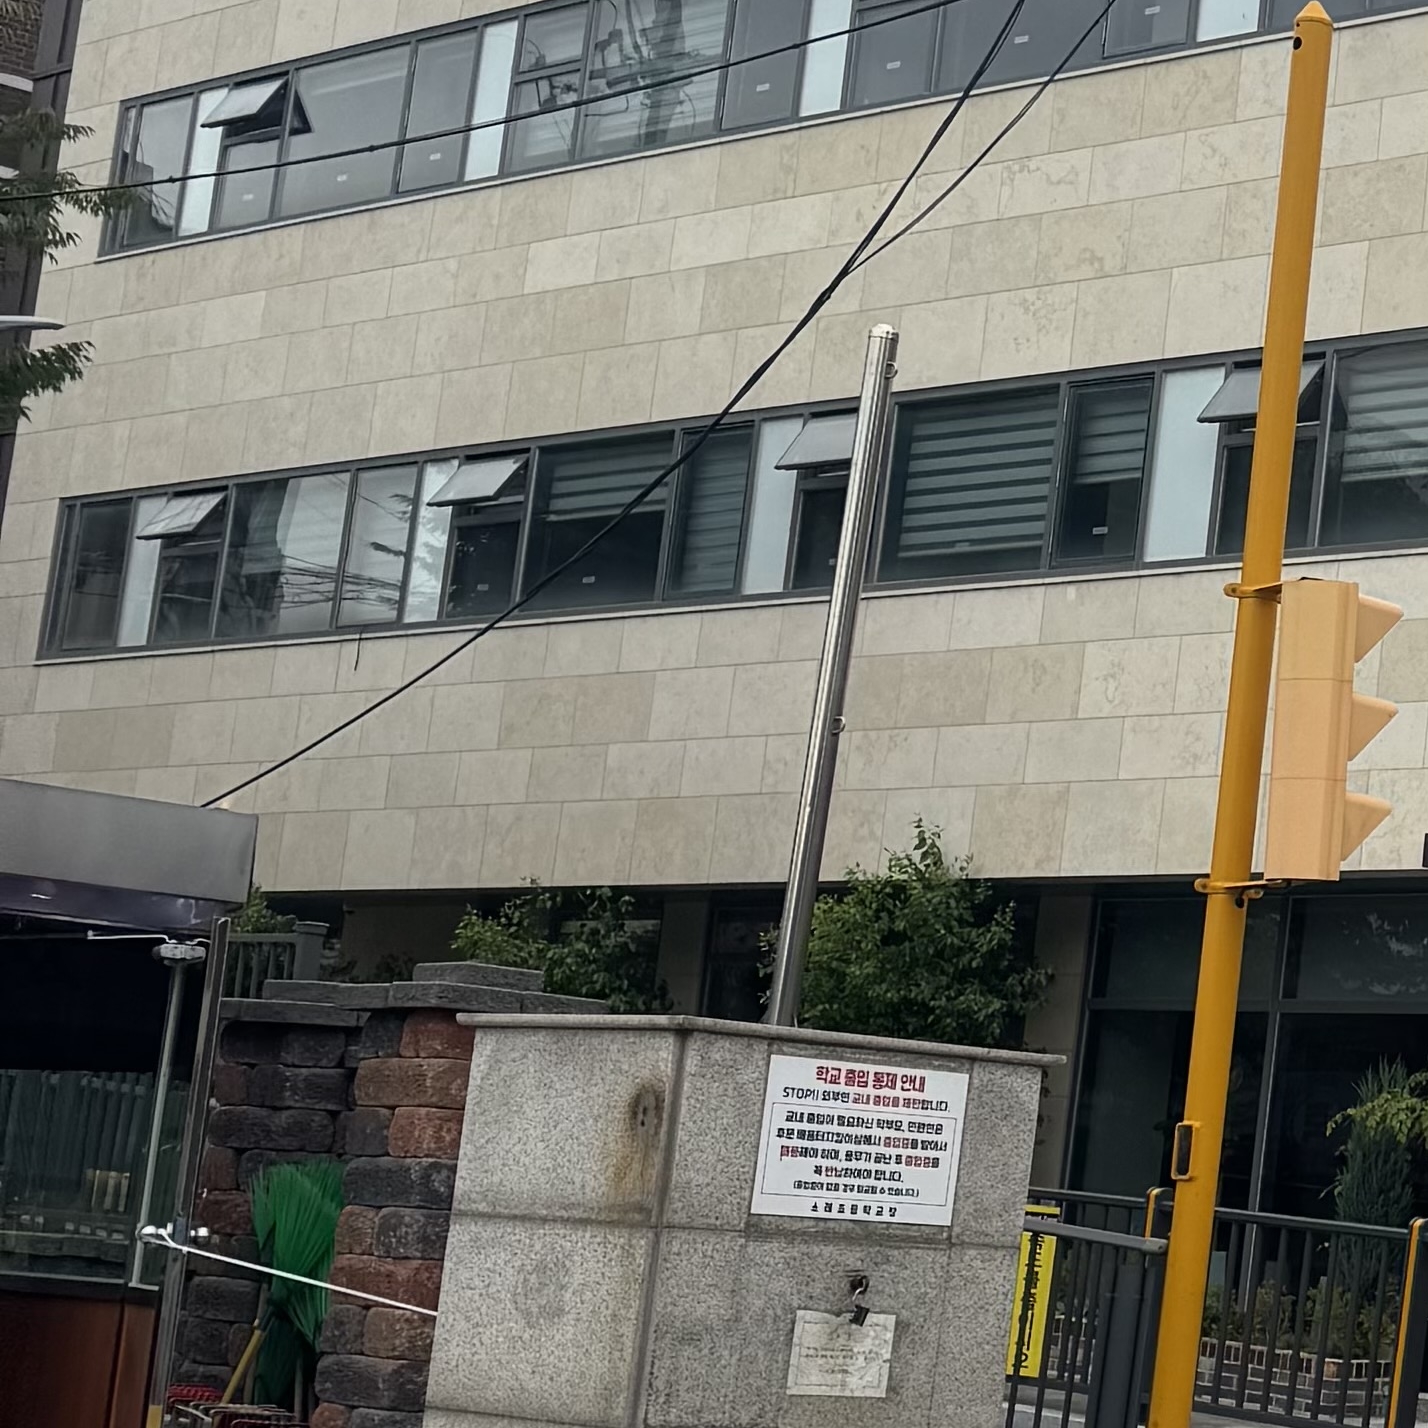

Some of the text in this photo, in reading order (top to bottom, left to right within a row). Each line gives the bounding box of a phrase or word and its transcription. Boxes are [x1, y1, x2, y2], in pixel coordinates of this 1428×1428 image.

[816, 1066, 926, 1093] 학교 출입 통제 안내
